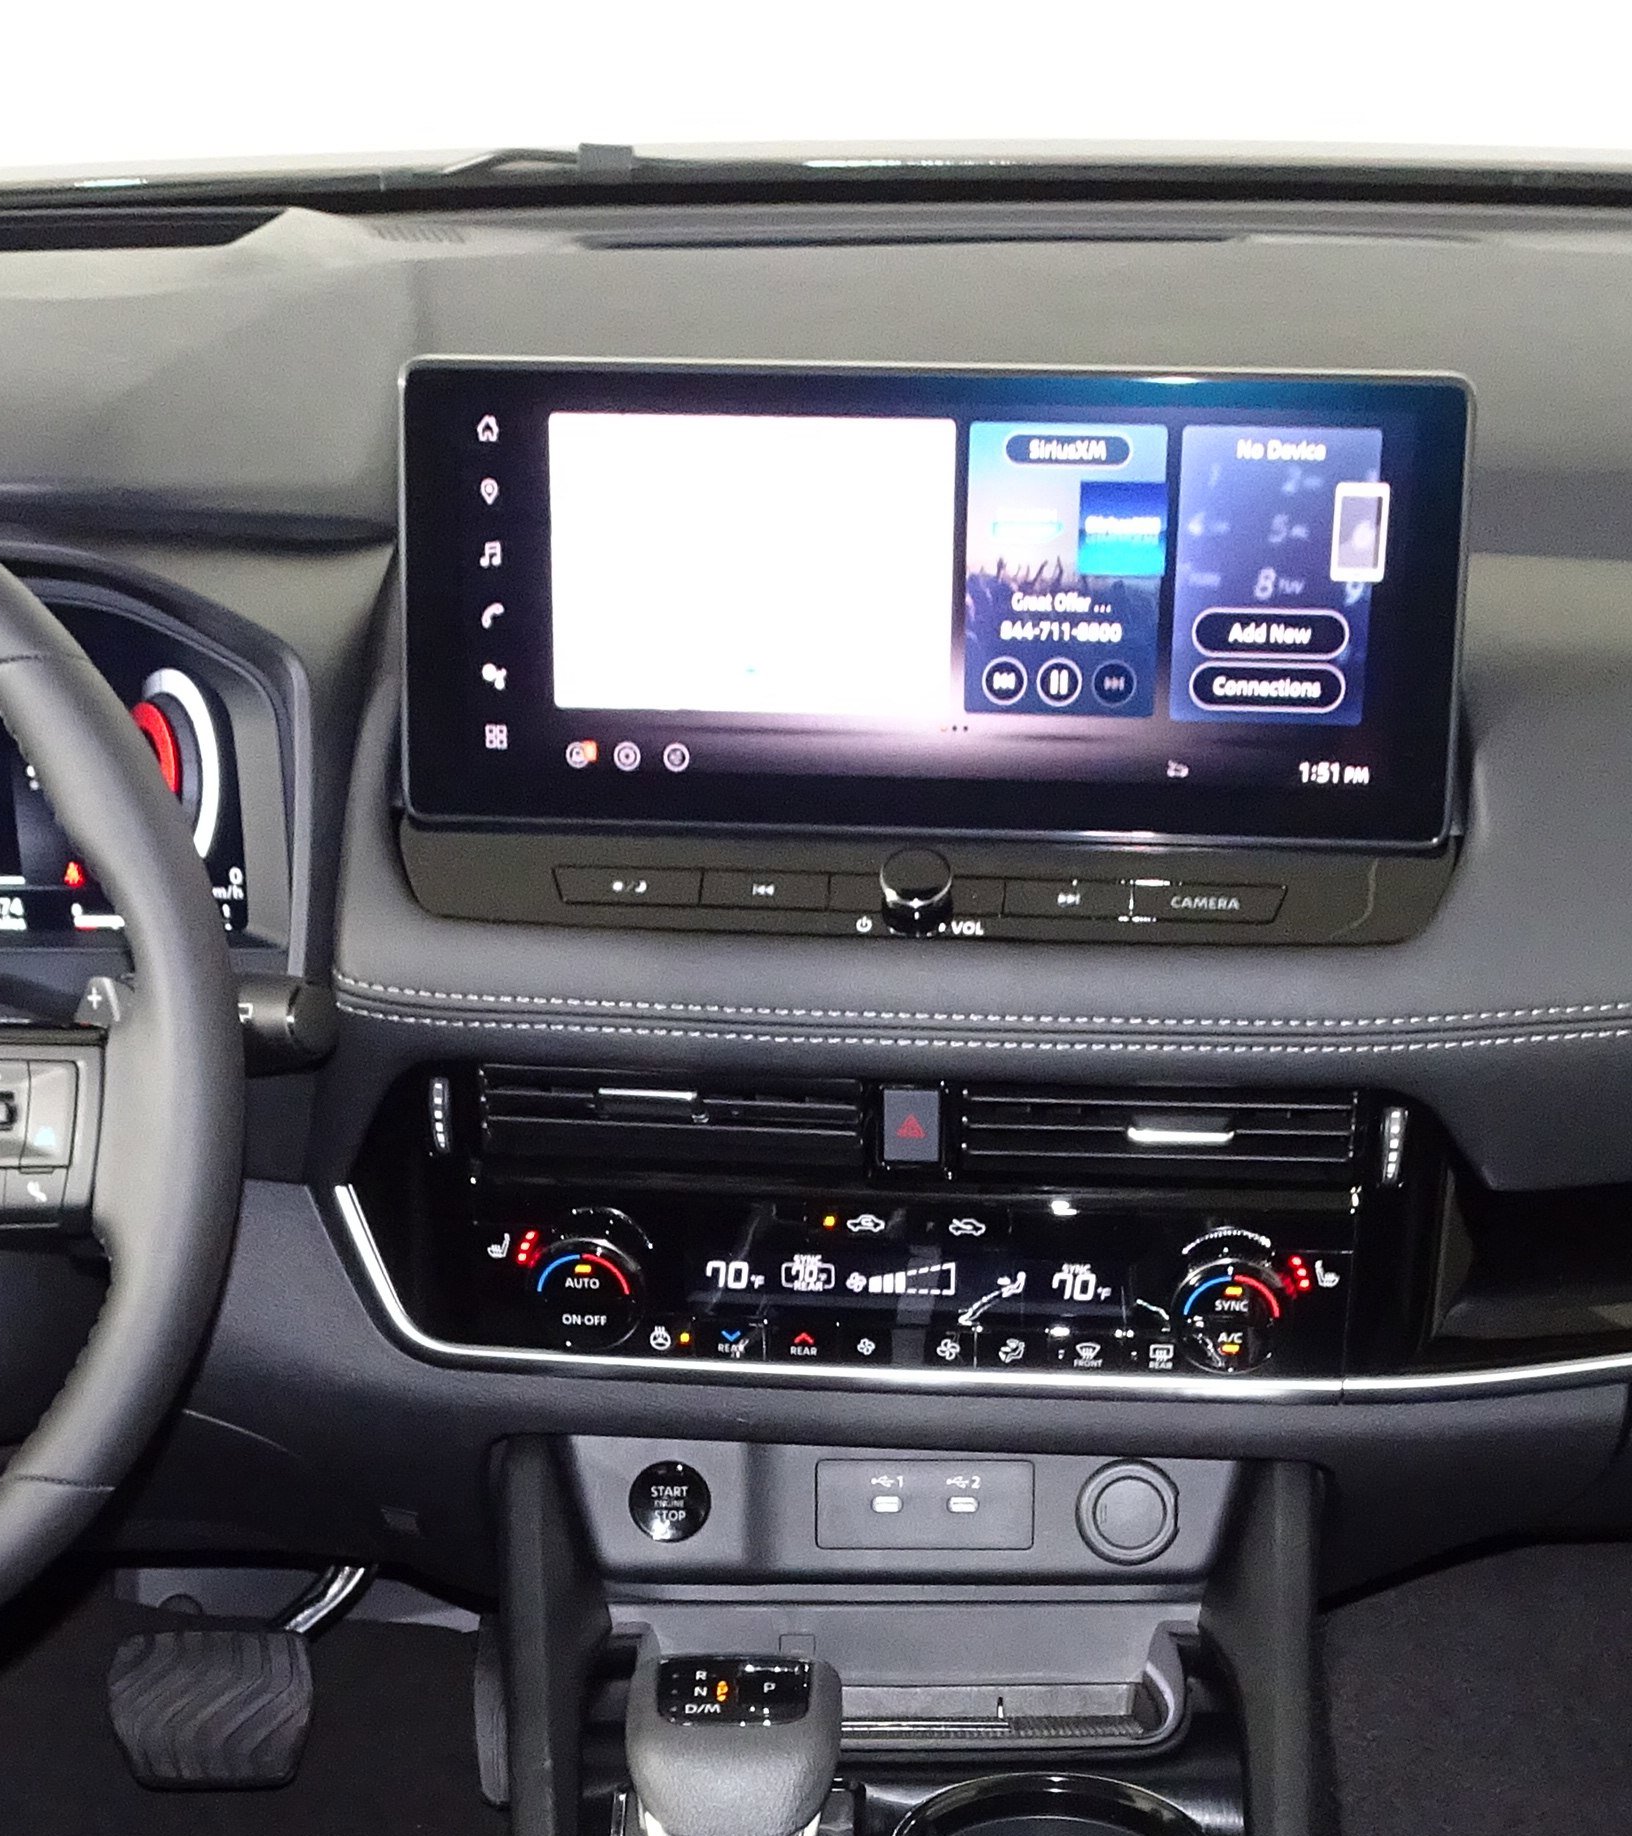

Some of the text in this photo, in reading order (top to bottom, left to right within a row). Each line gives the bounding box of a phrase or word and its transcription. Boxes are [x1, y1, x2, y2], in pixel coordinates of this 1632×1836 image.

[1029, 439, 1106, 460] SiriusXM
[1236, 439, 1326, 461] No Device
[1011, 592, 1052, 612] Great
[1054, 592, 1091, 612] Offer
[1228, 622, 1312, 644] Add New
[1212, 676, 1321, 698] Connections
[1299, 761, 1369, 784] 1:51 PM
[228, 866, 243, 885] 0
[1171, 896, 1240, 911] CAMERA
[951, 921, 984, 935] VOL
[564, 1277, 600, 1289] AUTO
[1214, 1300, 1248, 1312] SYNC
[1218, 1332, 1243, 1343] A/C
[790, 1346, 817, 1356] REAR
[897, 1476, 904, 1488] 1
[971, 1476, 981, 1489] 2
[650, 1485, 688, 1497] START
[654, 1511, 686, 1521] STOP
[695, 1670, 707, 1680] R
[694, 1686, 707, 1697] N
[763, 1682, 776, 1693] P
[684, 1704, 721, 1714] D/M
